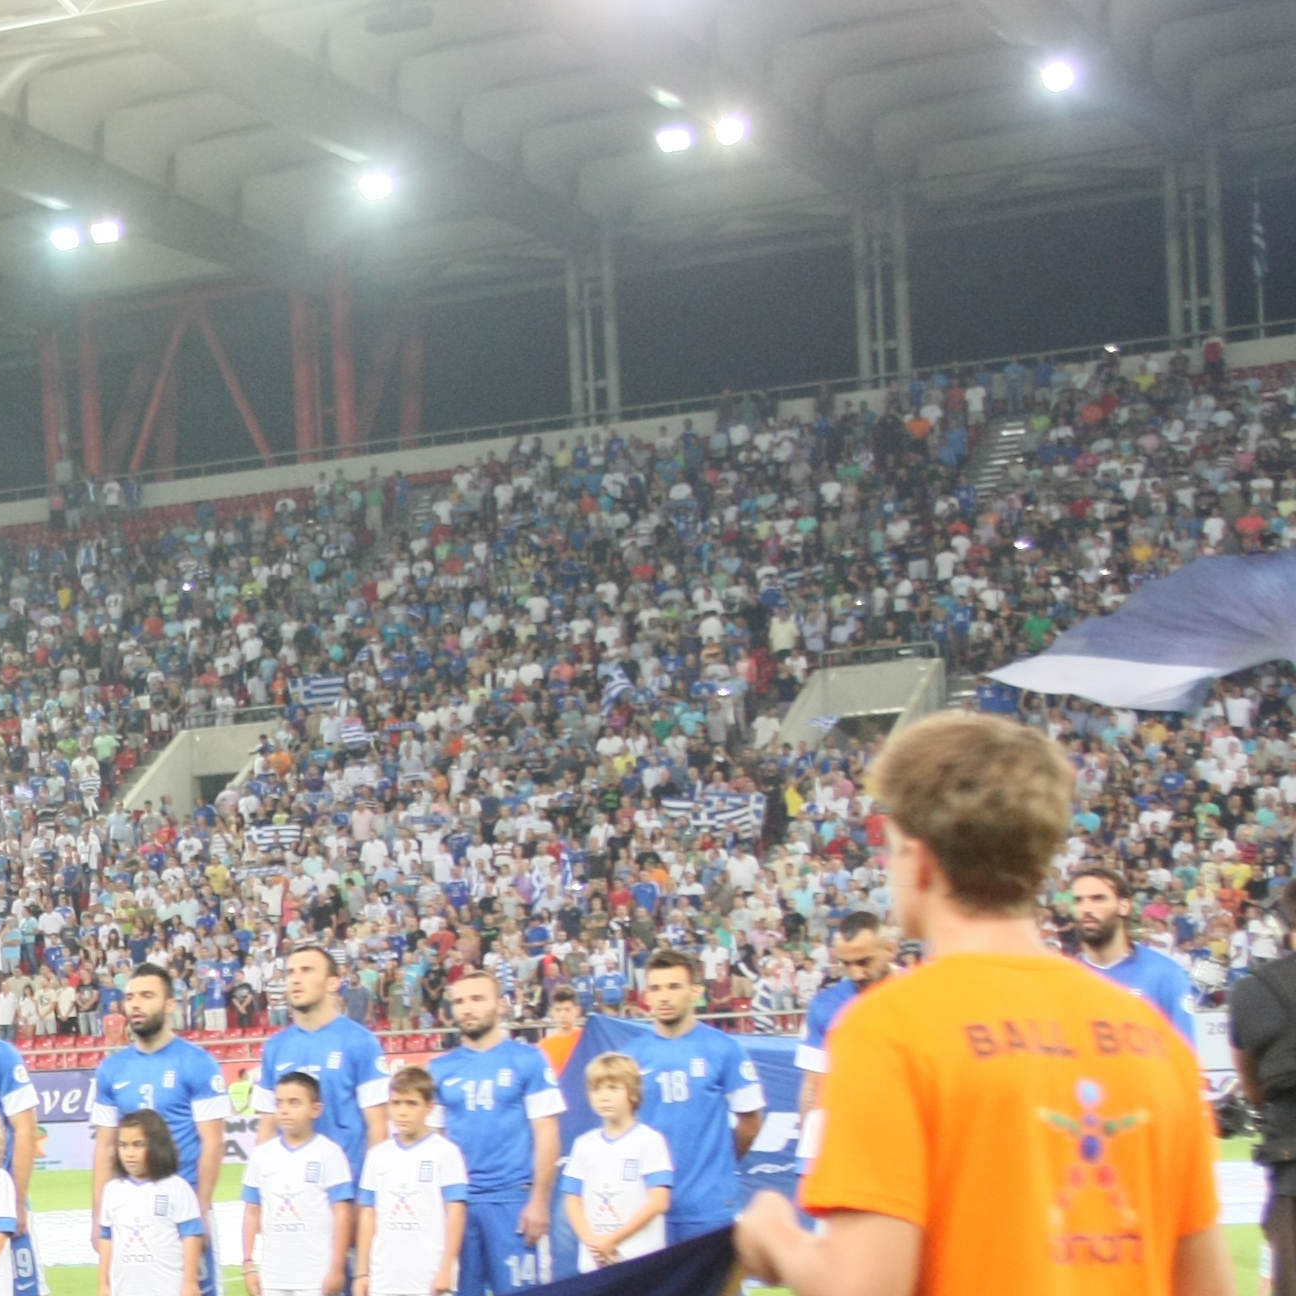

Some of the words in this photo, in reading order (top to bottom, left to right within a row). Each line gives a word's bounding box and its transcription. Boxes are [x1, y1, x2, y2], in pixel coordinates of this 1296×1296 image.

[965, 1020, 1078, 1058] BALL
[461, 1079, 495, 1111] 14
[656, 1070, 690, 1104] 18
[505, 1253, 538, 1287] 14
